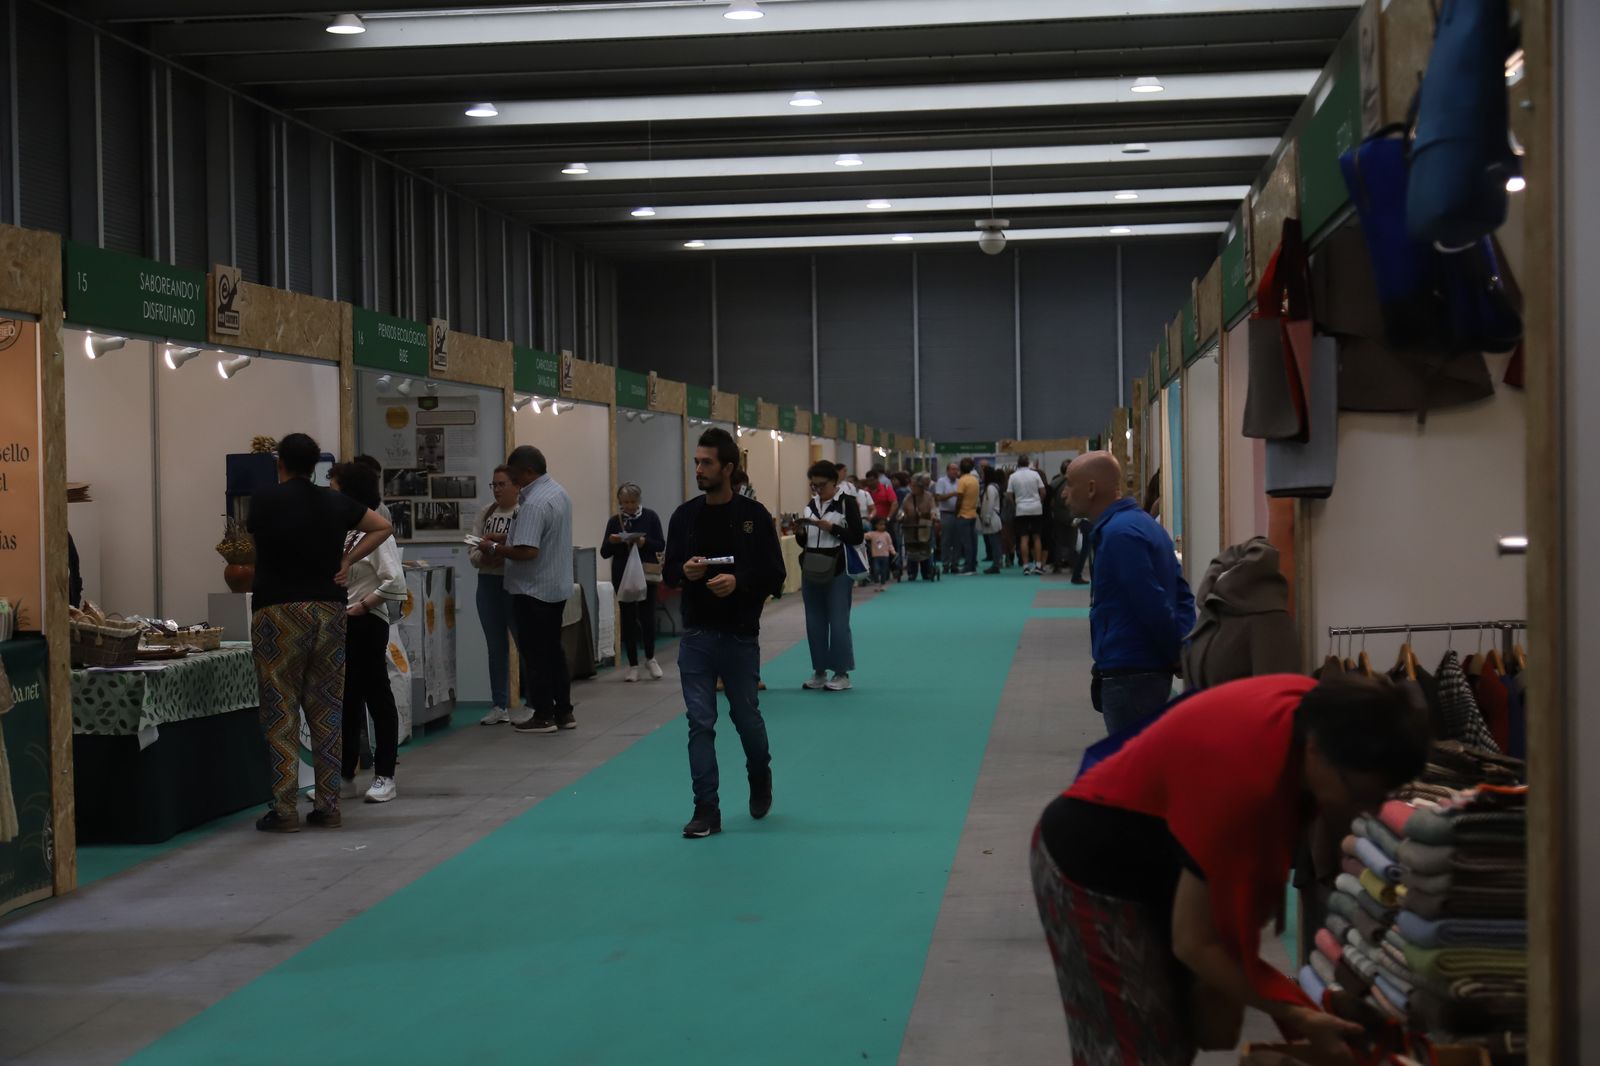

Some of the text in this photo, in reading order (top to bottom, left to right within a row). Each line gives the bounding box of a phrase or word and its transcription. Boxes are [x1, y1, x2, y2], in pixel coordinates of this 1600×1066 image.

[77, 271, 88, 292] 15
[140, 272, 201, 301] SABOREANDO Y
[143, 301, 195, 327] DISFRUTANDO
